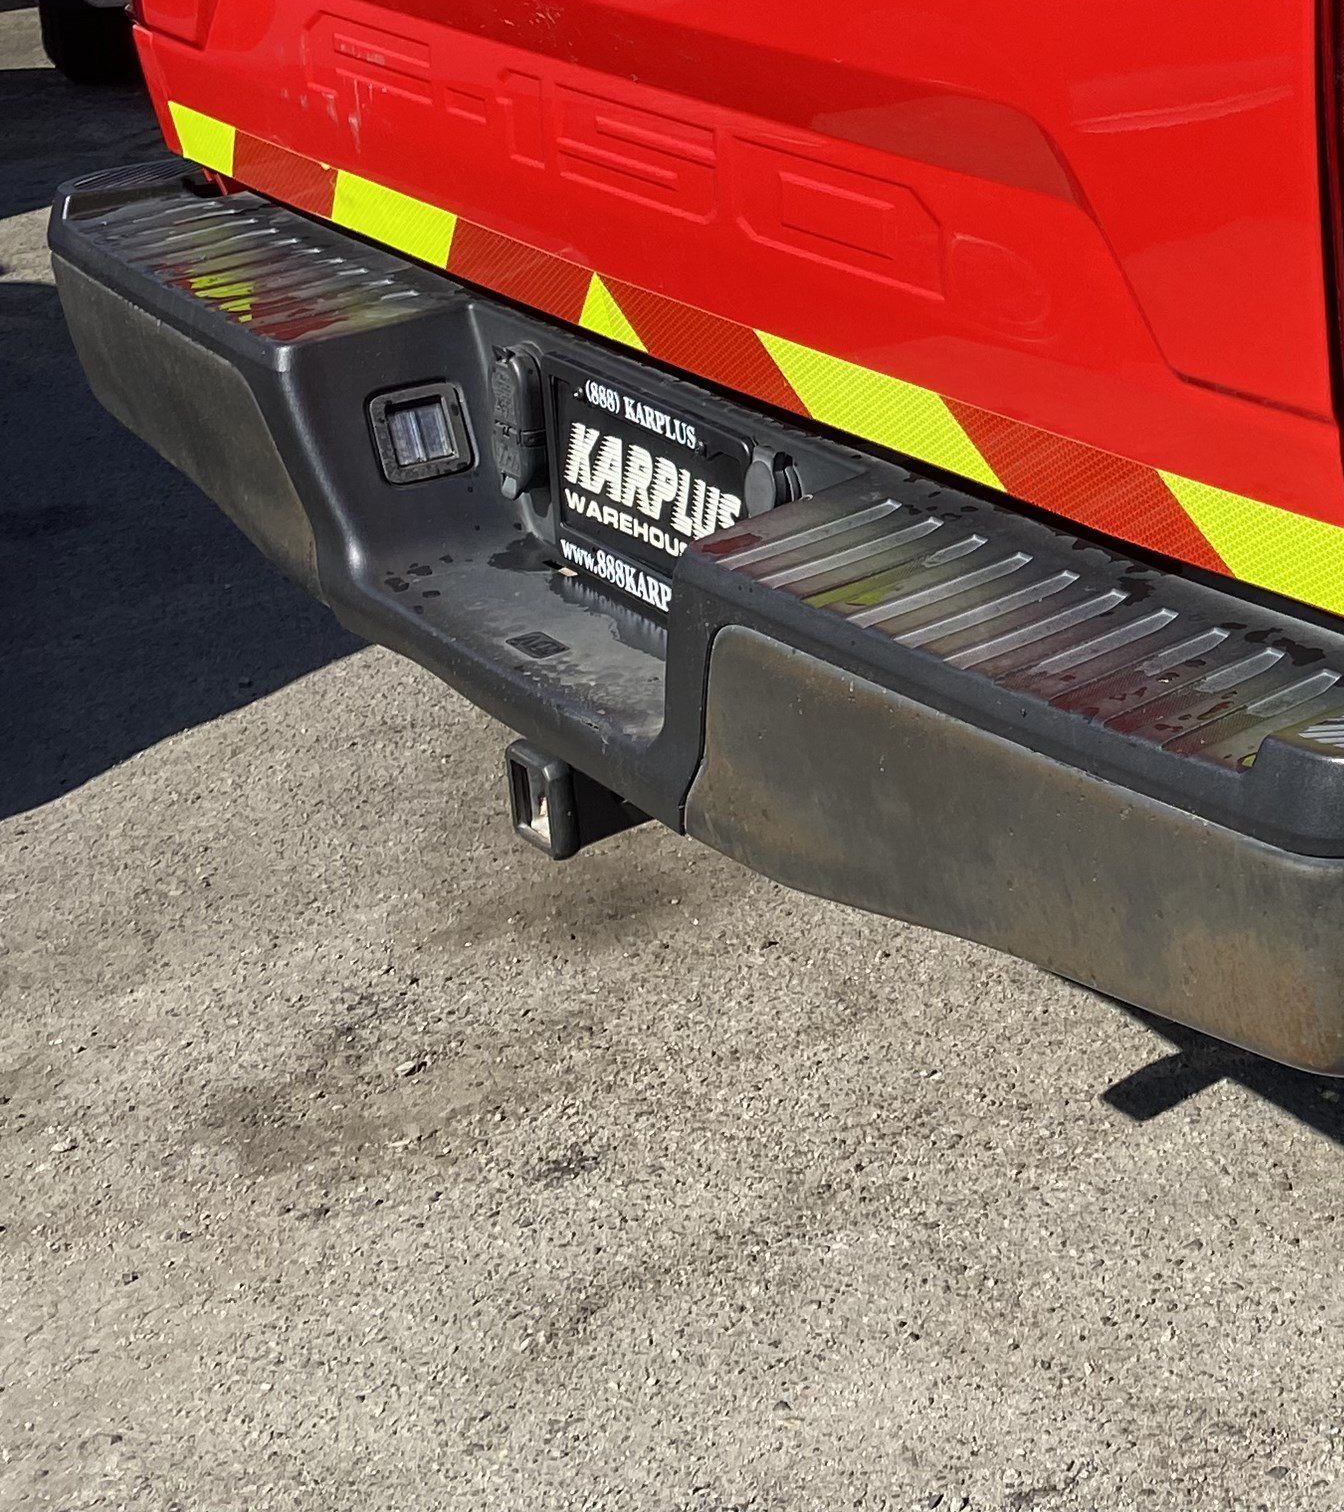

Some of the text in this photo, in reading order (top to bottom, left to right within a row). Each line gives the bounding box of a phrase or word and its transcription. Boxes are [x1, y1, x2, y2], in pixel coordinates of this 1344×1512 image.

[301, 9, 947, 304] F-150
[585, 379, 696, 450] (888) KARPLUS
[563, 421, 742, 541] KARPLUS
